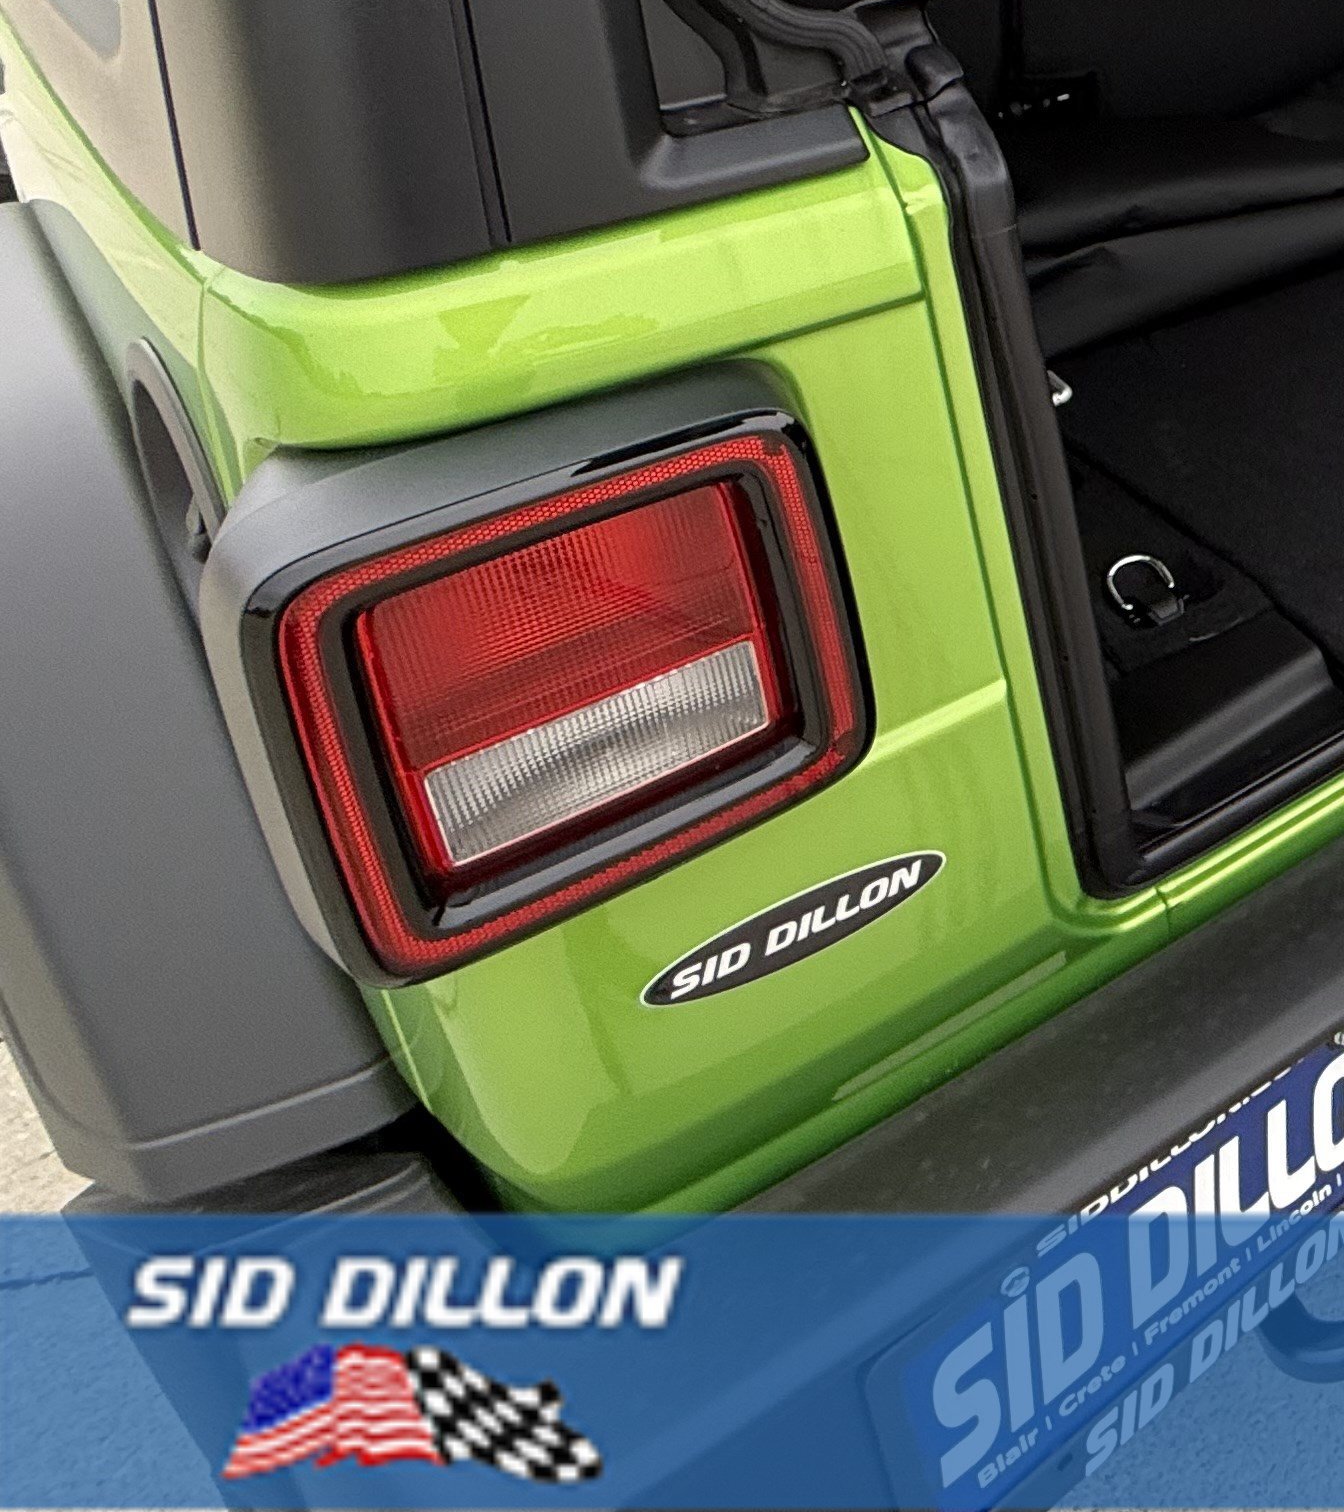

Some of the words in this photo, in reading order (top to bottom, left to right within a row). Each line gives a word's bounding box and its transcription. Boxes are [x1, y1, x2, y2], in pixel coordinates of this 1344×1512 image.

[670, 942, 751, 1000] SID
[764, 859, 922, 958] DILLON
[932, 1252, 1104, 1489] SID
[976, 1417, 1039, 1489] Blair
[1058, 1354, 1127, 1417] Crete
[1143, 1257, 1242, 1346] Fremont
[1256, 1183, 1333, 1252] Lincoln
[1085, 1363, 1175, 1478] SID
